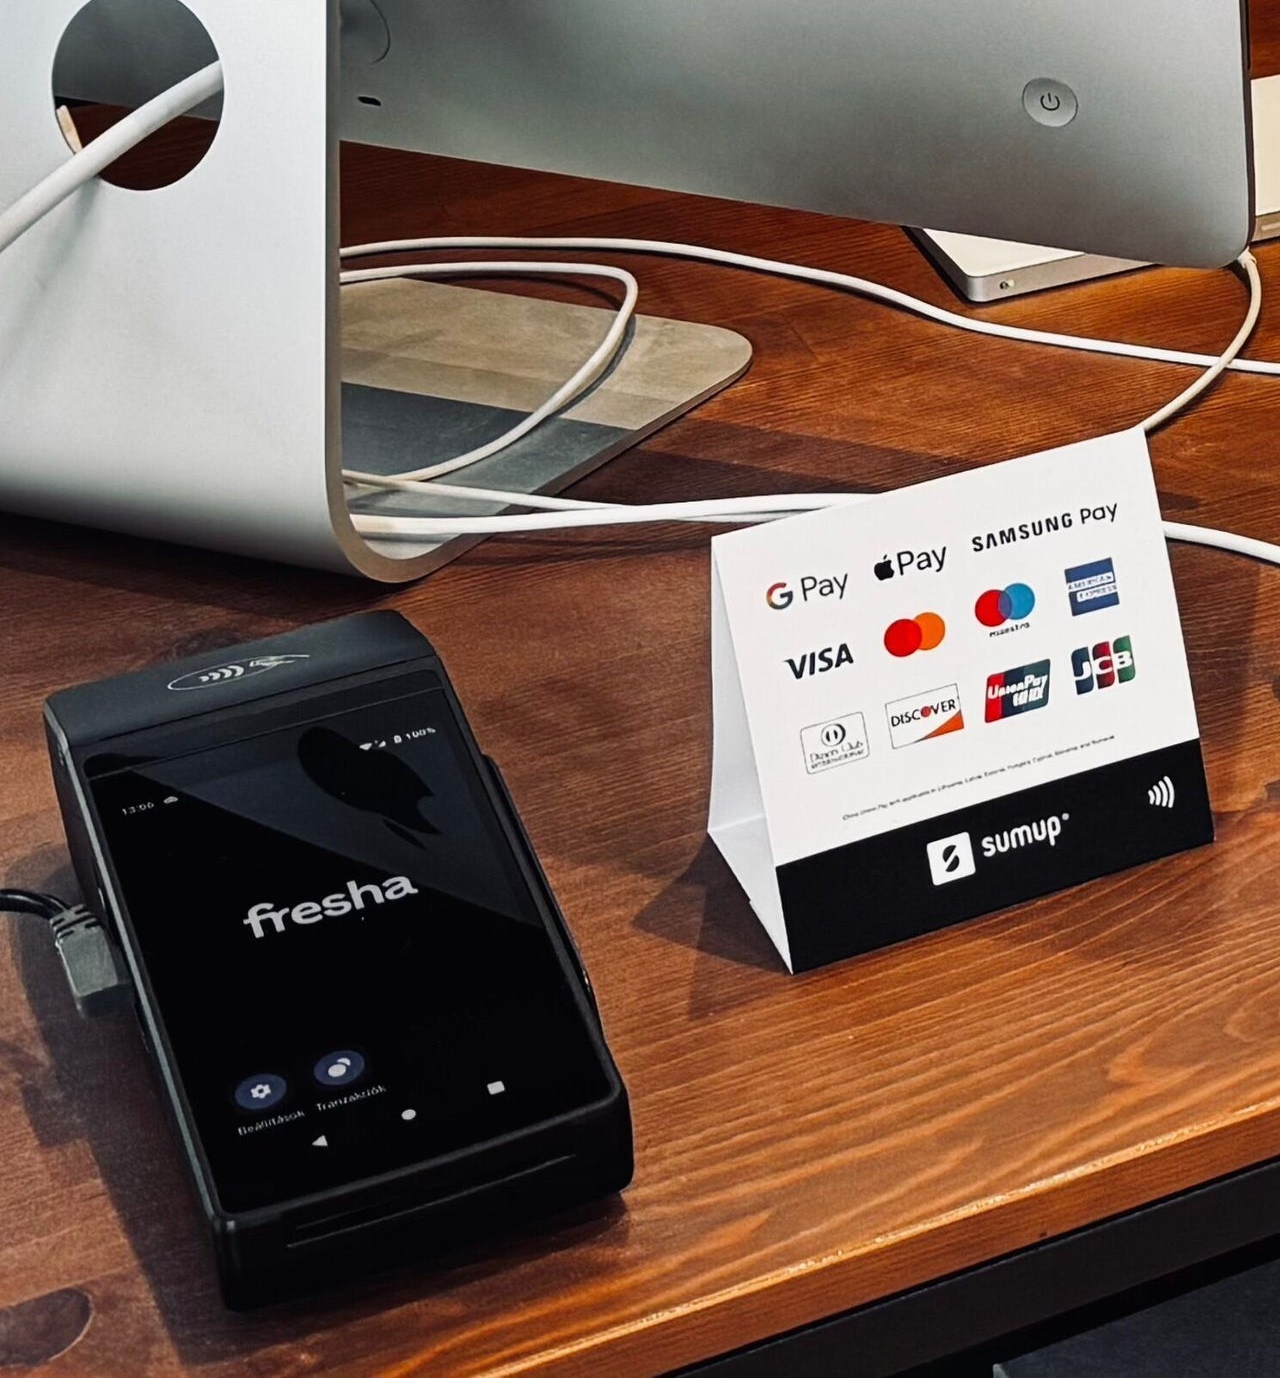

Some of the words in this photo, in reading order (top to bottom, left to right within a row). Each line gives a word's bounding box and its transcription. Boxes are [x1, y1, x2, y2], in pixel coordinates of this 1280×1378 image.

[971, 512, 1073, 552] SAMSUNG
[1080, 502, 1118, 525] Pay
[896, 546, 947, 576] Pay
[800, 573, 848, 602] Pay
[782, 643, 855, 680] VISA
[1073, 651, 1133, 682] JCB
[987, 674, 1049, 700] UnionPay
[890, 699, 957, 728] DISCOVER
[243, 876, 418, 938] fresha
